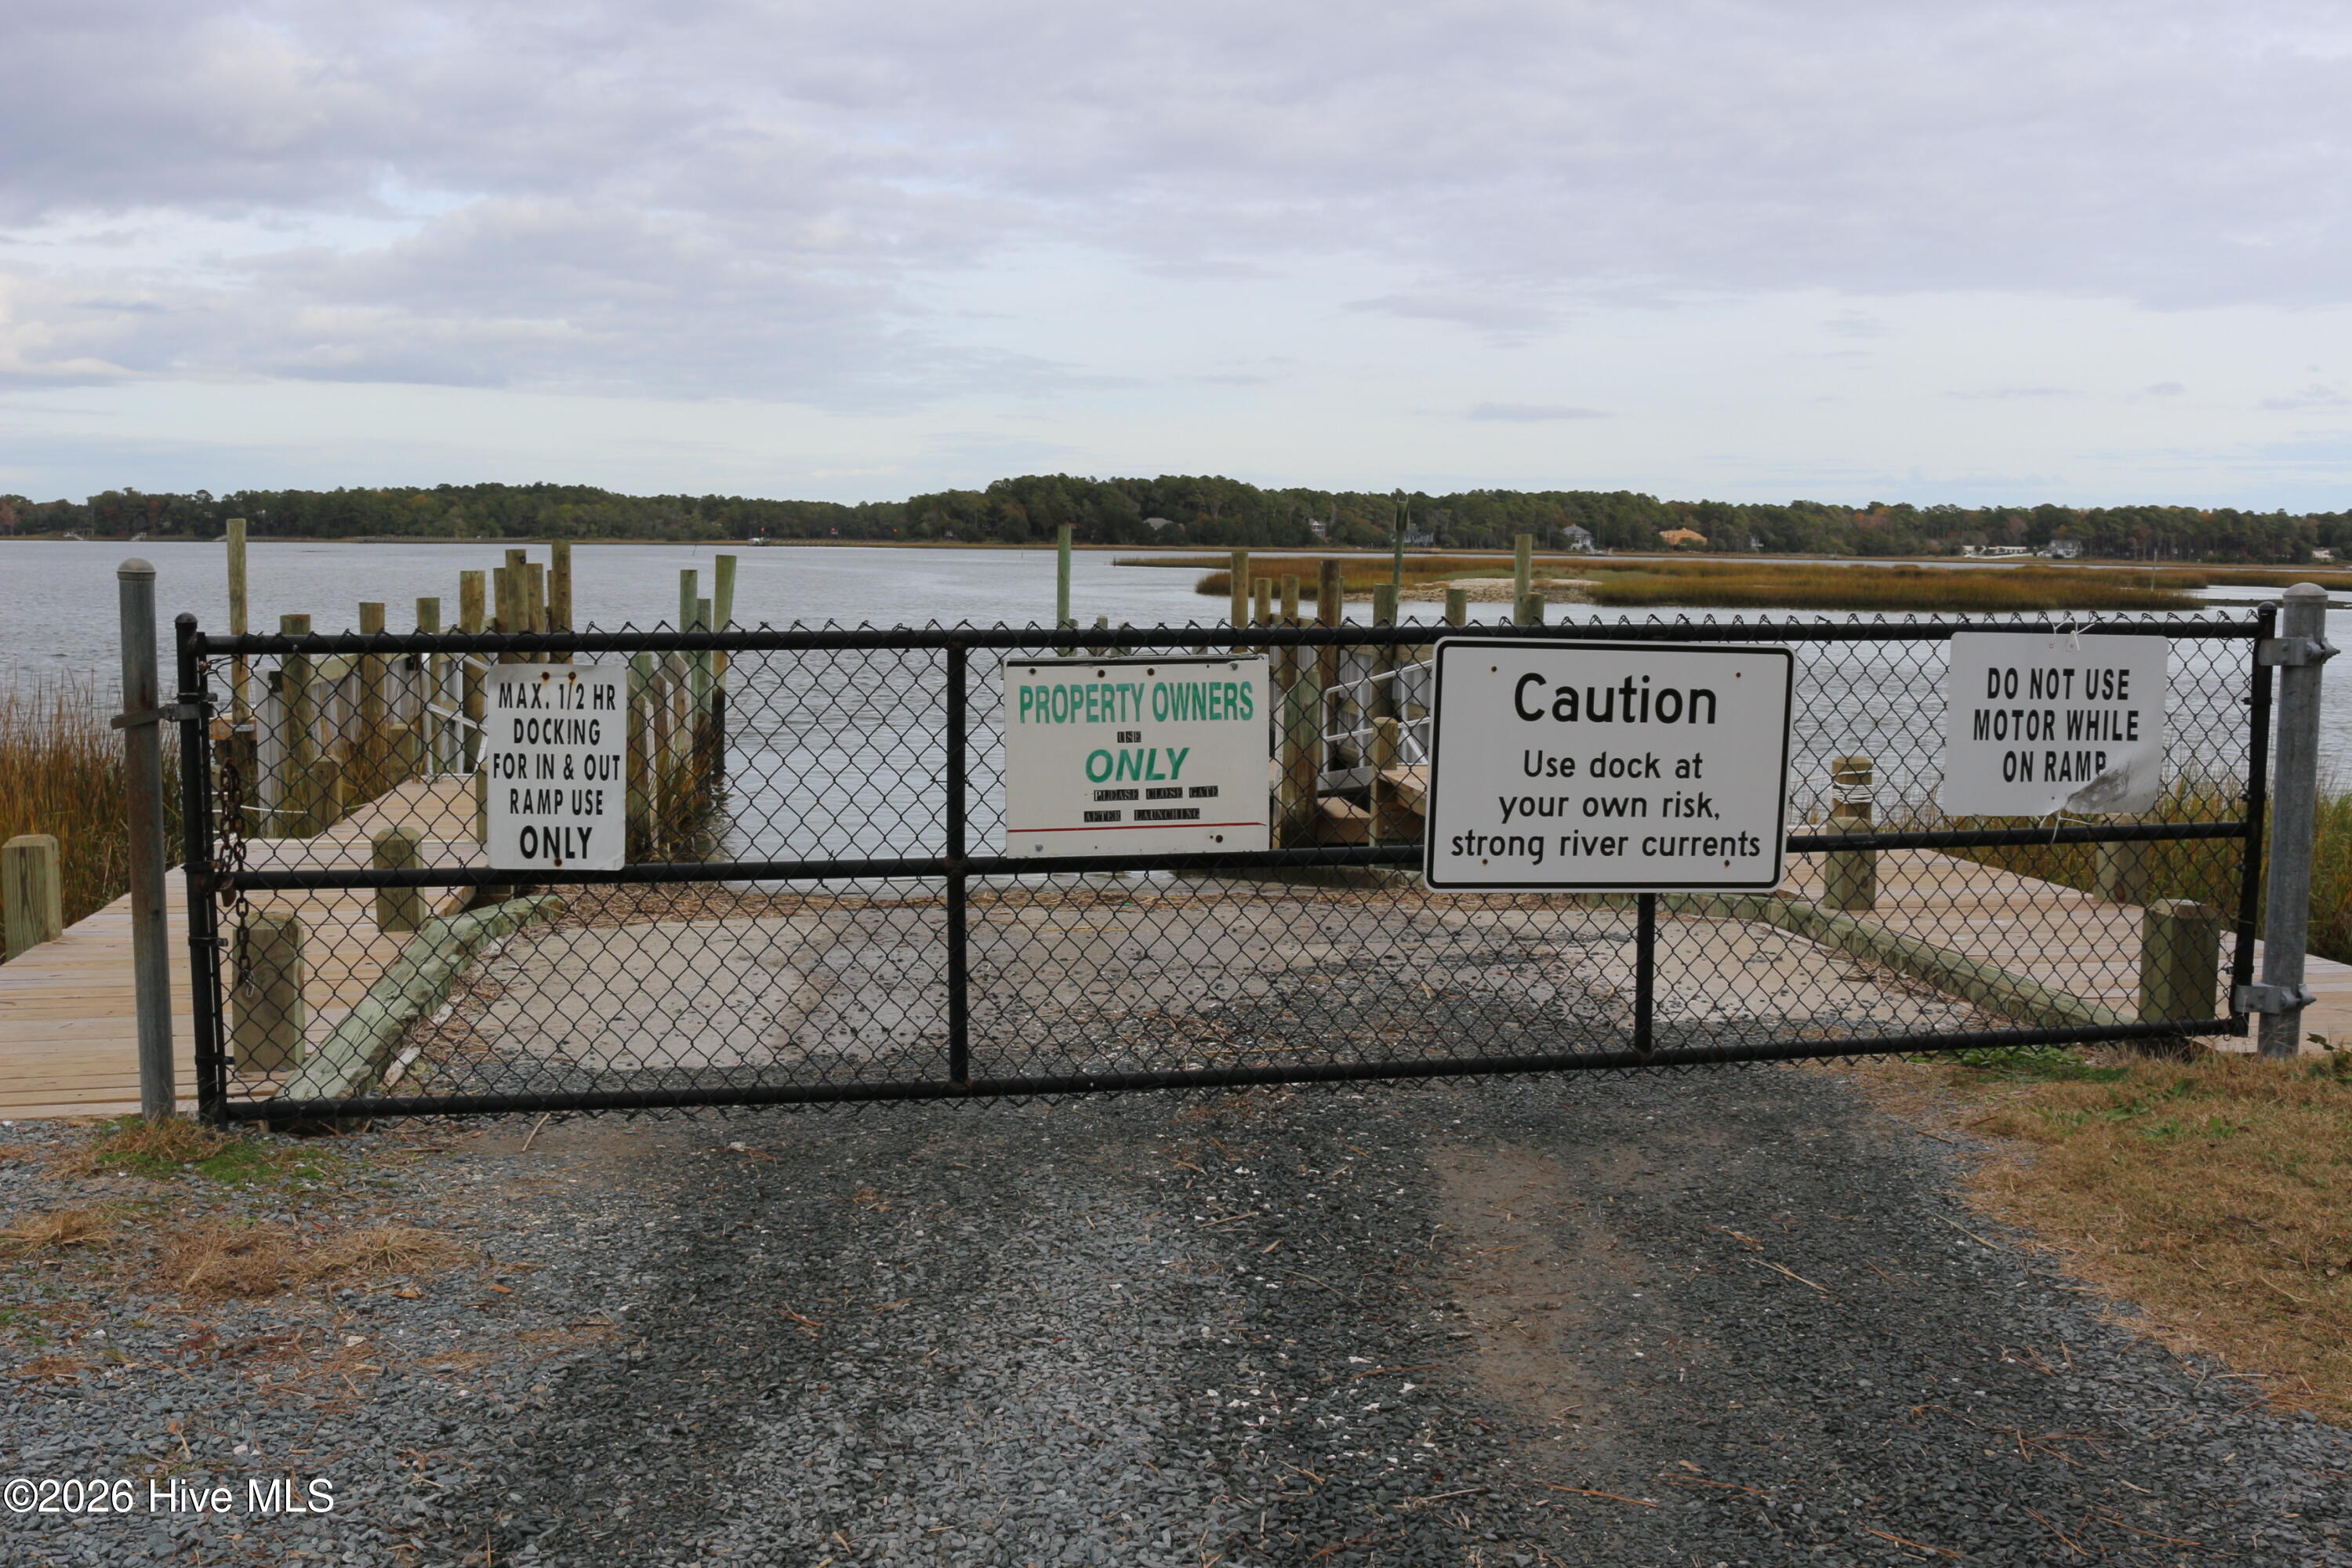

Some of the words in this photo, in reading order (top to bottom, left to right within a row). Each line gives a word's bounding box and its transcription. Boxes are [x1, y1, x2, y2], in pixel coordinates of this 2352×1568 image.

[499, 681, 550, 710] MAX.
[558, 681, 584, 710] 1/2
[593, 682, 617, 711] HR
[1513, 671, 1718, 725] Caution
[1987, 667, 2020, 700] DO
[2028, 667, 2076, 701] NOT
[2085, 668, 2131, 702] USE
[1018, 681, 1145, 724] PROPERTY
[1151, 680, 1254, 722] OWNERS
[513, 717, 601, 746] DOCKING
[1116, 731, 1142, 743] USE
[1973, 709, 2056, 742] MOTOR
[2065, 709, 2140, 742] WHILE
[492, 752, 528, 780] FOR
[535, 753, 554, 780] IN
[562, 753, 575, 781] &
[583, 753, 621, 782] OUT
[1083, 747, 1191, 784] ONLY
[1523, 749, 1577, 779] Use
[1588, 751, 1662, 779] dock
[1674, 752, 1704, 779] at
[2002, 750, 2035, 783] ON
[2043, 750, 2108, 783] RAMP
[509, 787, 564, 815] RAMP
[571, 789, 604, 816] USE
[1093, 789, 1139, 801] PLEASE
[1145, 786, 1183, 800] CLOSE
[1189, 785, 1219, 798] GATE
[1498, 796, 1570, 825] your
[1581, 797, 1648, 818] own
[1661, 790, 1720, 821] risk,
[1083, 810, 1122, 822] AFTER
[1134, 808, 1200, 821] LAUNCHING
[519, 824, 593, 860] ONLY
[1450, 829, 1544, 866] strong
[1559, 829, 1629, 858] river
[1641, 830, 1761, 858] currents
